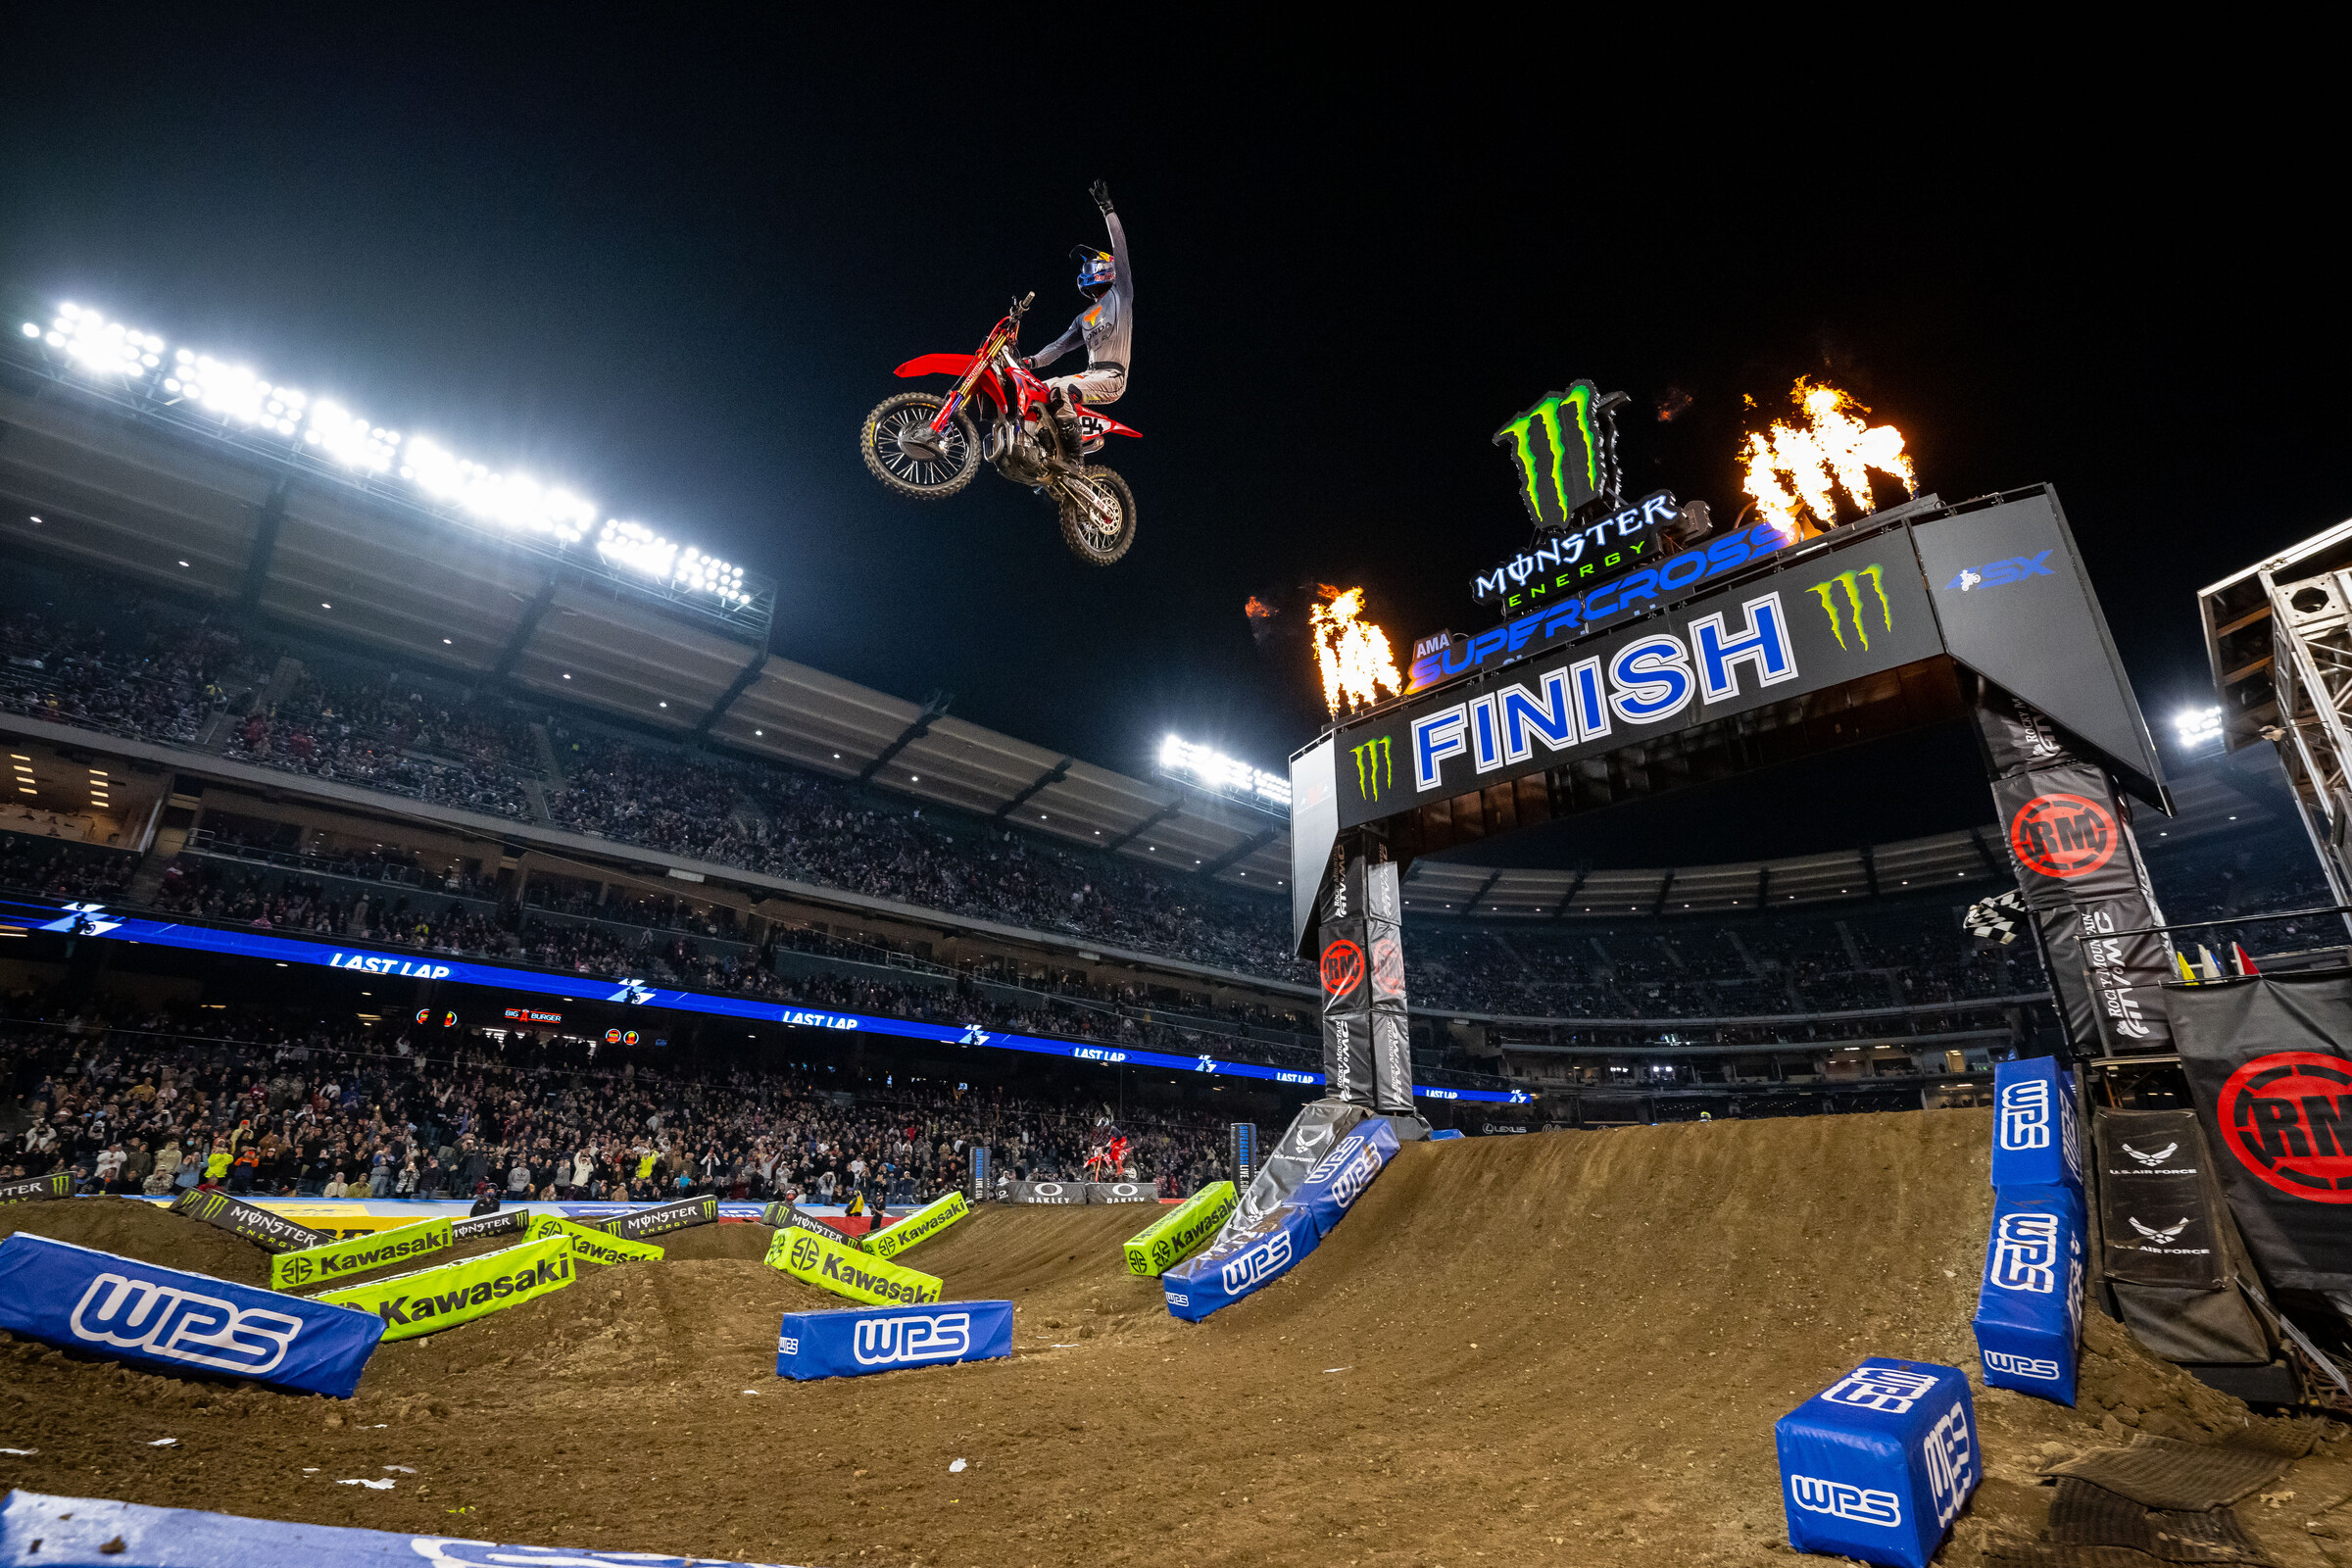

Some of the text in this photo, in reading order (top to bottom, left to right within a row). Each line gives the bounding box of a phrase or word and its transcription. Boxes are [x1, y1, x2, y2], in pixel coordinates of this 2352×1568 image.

[1082, 416, 1104, 434] 94
[1508, 540, 1645, 607] ENERGY
[1407, 521, 1793, 694] SUPERCROSS
[1416, 633, 1450, 658] AMA
[1410, 591, 1799, 793] FINISH
[330, 953, 450, 979] LAST LAP
[2082, 912, 2108, 974] MOUNAIN
[530, 1012, 562, 1021] BURGER
[783, 1011, 858, 1030] LAST LAP
[1074, 1048, 1125, 1062] LAST LAP
[1277, 1072, 1314, 1084] LAST LAP
[1426, 1090, 1444, 1099] LAST
[2000, 1079, 2050, 1151] WPS
[0, 1182, 43, 1198] TER
[1332, 1142, 1382, 1207] WPS
[236, 1225, 297, 1251] ENERGY
[640, 1220, 689, 1235] ENERGY
[898, 1198, 965, 1246] Kawasaki
[1171, 1192, 1239, 1253] Kawasaki
[320, 1229, 449, 1274] Kawasaki
[1222, 1230, 1292, 1296] WPS
[1990, 1213, 2058, 1294] WPS
[379, 1252, 568, 1328] Kawasaki
[822, 1252, 938, 1304] Kawasaki
[1165, 1292, 1189, 1306] WPS
[71, 1273, 303, 1374] WPS
[778, 1337, 798, 1355] WPS
[854, 1313, 970, 1365] WPS
[1984, 1349, 2060, 1380] WPS
[1821, 1367, 1939, 1414] WPS
[1790, 1474, 1901, 1528] WPS
